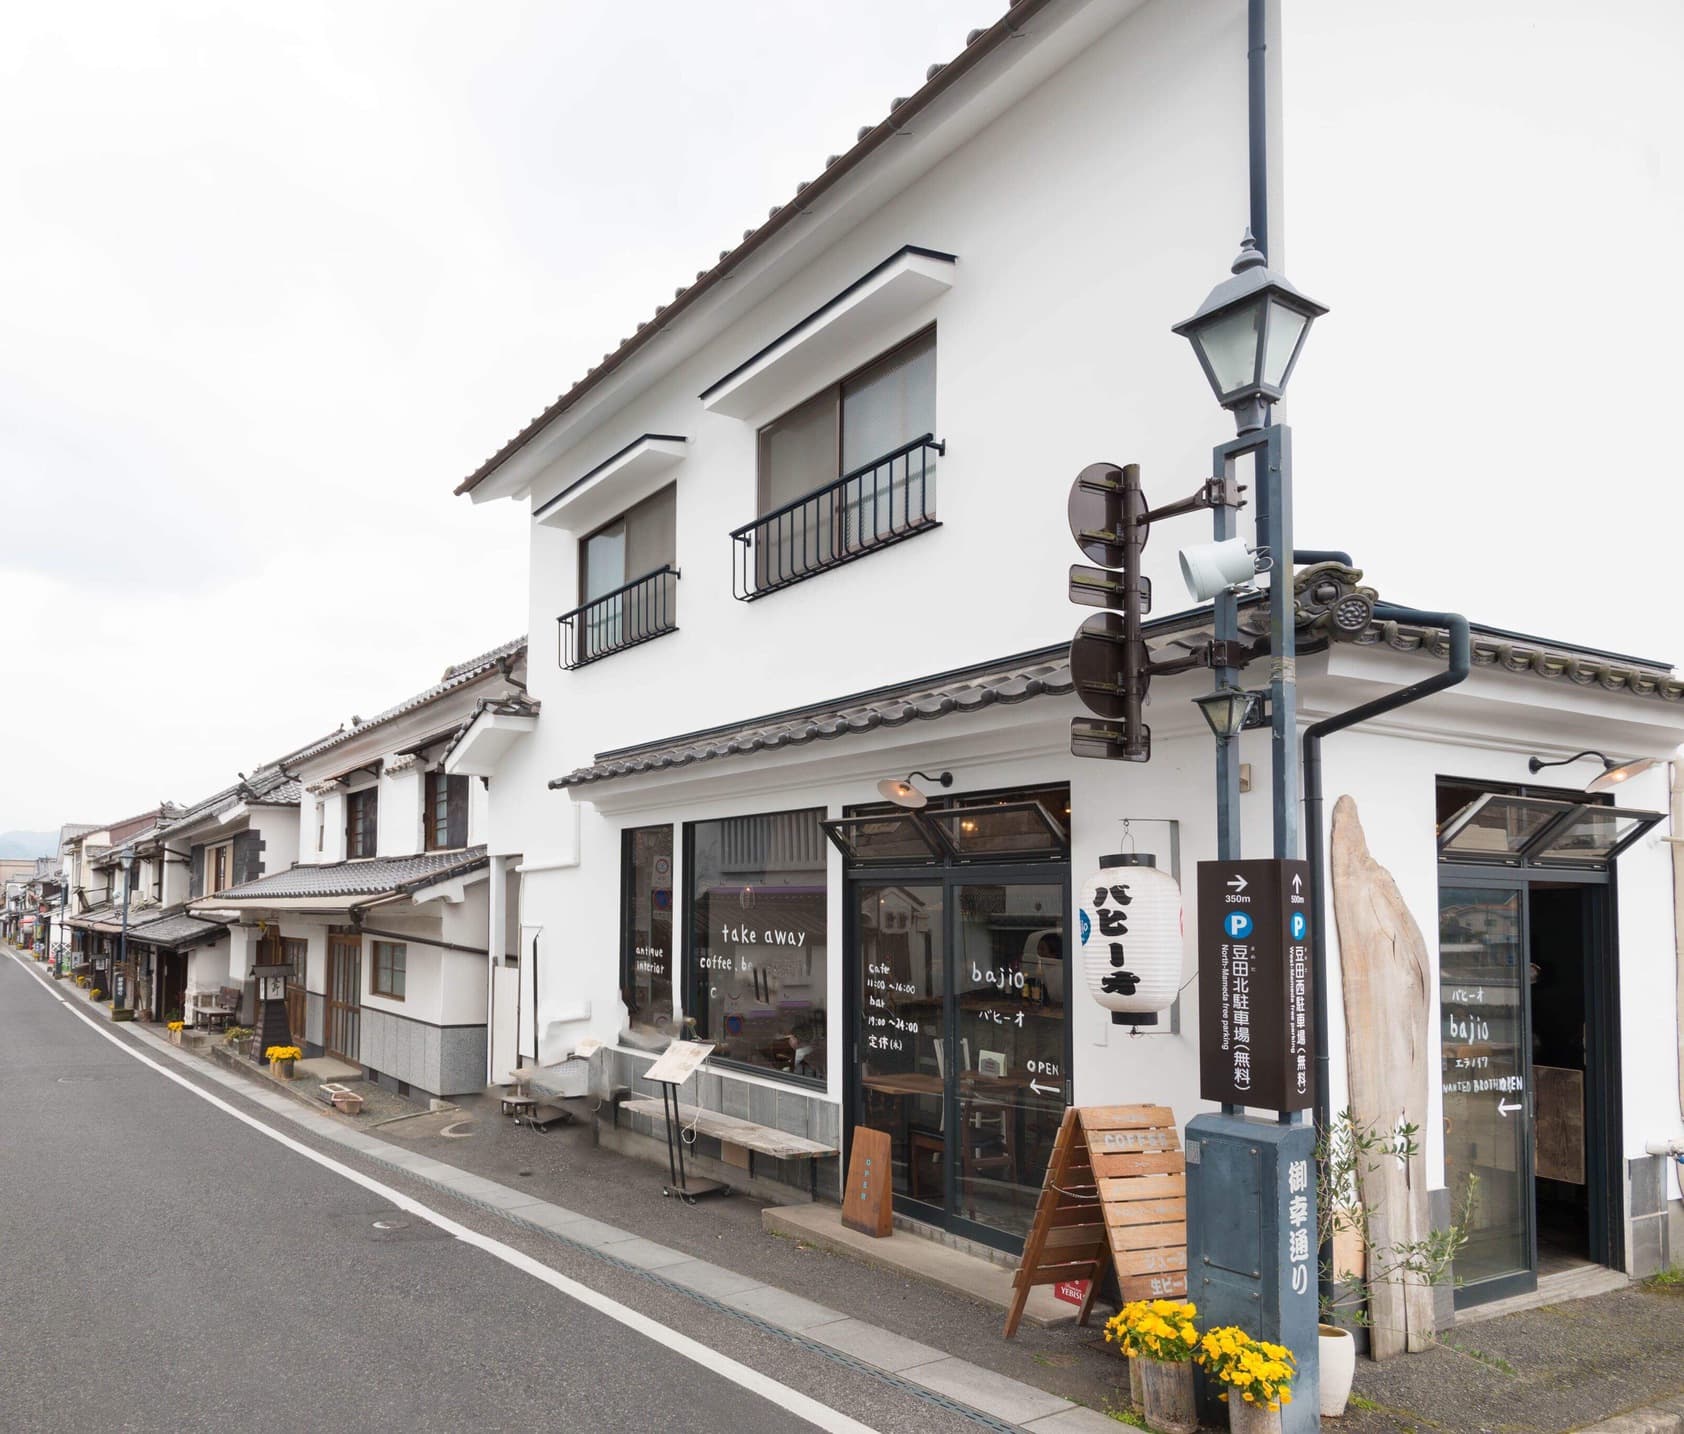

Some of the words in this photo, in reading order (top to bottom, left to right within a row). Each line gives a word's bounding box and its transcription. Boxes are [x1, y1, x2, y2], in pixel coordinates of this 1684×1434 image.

[1225, 894, 1251, 903] 350m
[1290, 895, 1304, 904] 500m
[1231, 915, 1247, 936] P
[1294, 916, 1303, 937] P
[722, 924, 757, 944] take
[764, 928, 806, 947] away
[1093, 884, 1141, 996] バヒーオ
[635, 946, 664, 958] antique
[636, 960, 665, 975] interior
[971, 961, 1025, 989] bajio
[1221, 944, 1230, 1001] North-Mameda
[867, 979, 886, 990] 11:00
[1452, 986, 1485, 1002] バヒーオ
[869, 995, 886, 1008] bar
[1221, 1003, 1230, 1019] free
[868, 1016, 886, 1027] 19:00
[978, 1009, 1025, 1028] バヒーオ
[1221, 1020, 1230, 1050] parking
[1450, 1013, 1489, 1045] bajio
[1027, 1060, 1060, 1076] OPEN
[1104, 1132, 1168, 1151] COFFEE
[1288, 1160, 1309, 1295] 御幸通り
[1151, 1275, 1187, 1297] 生ビー
